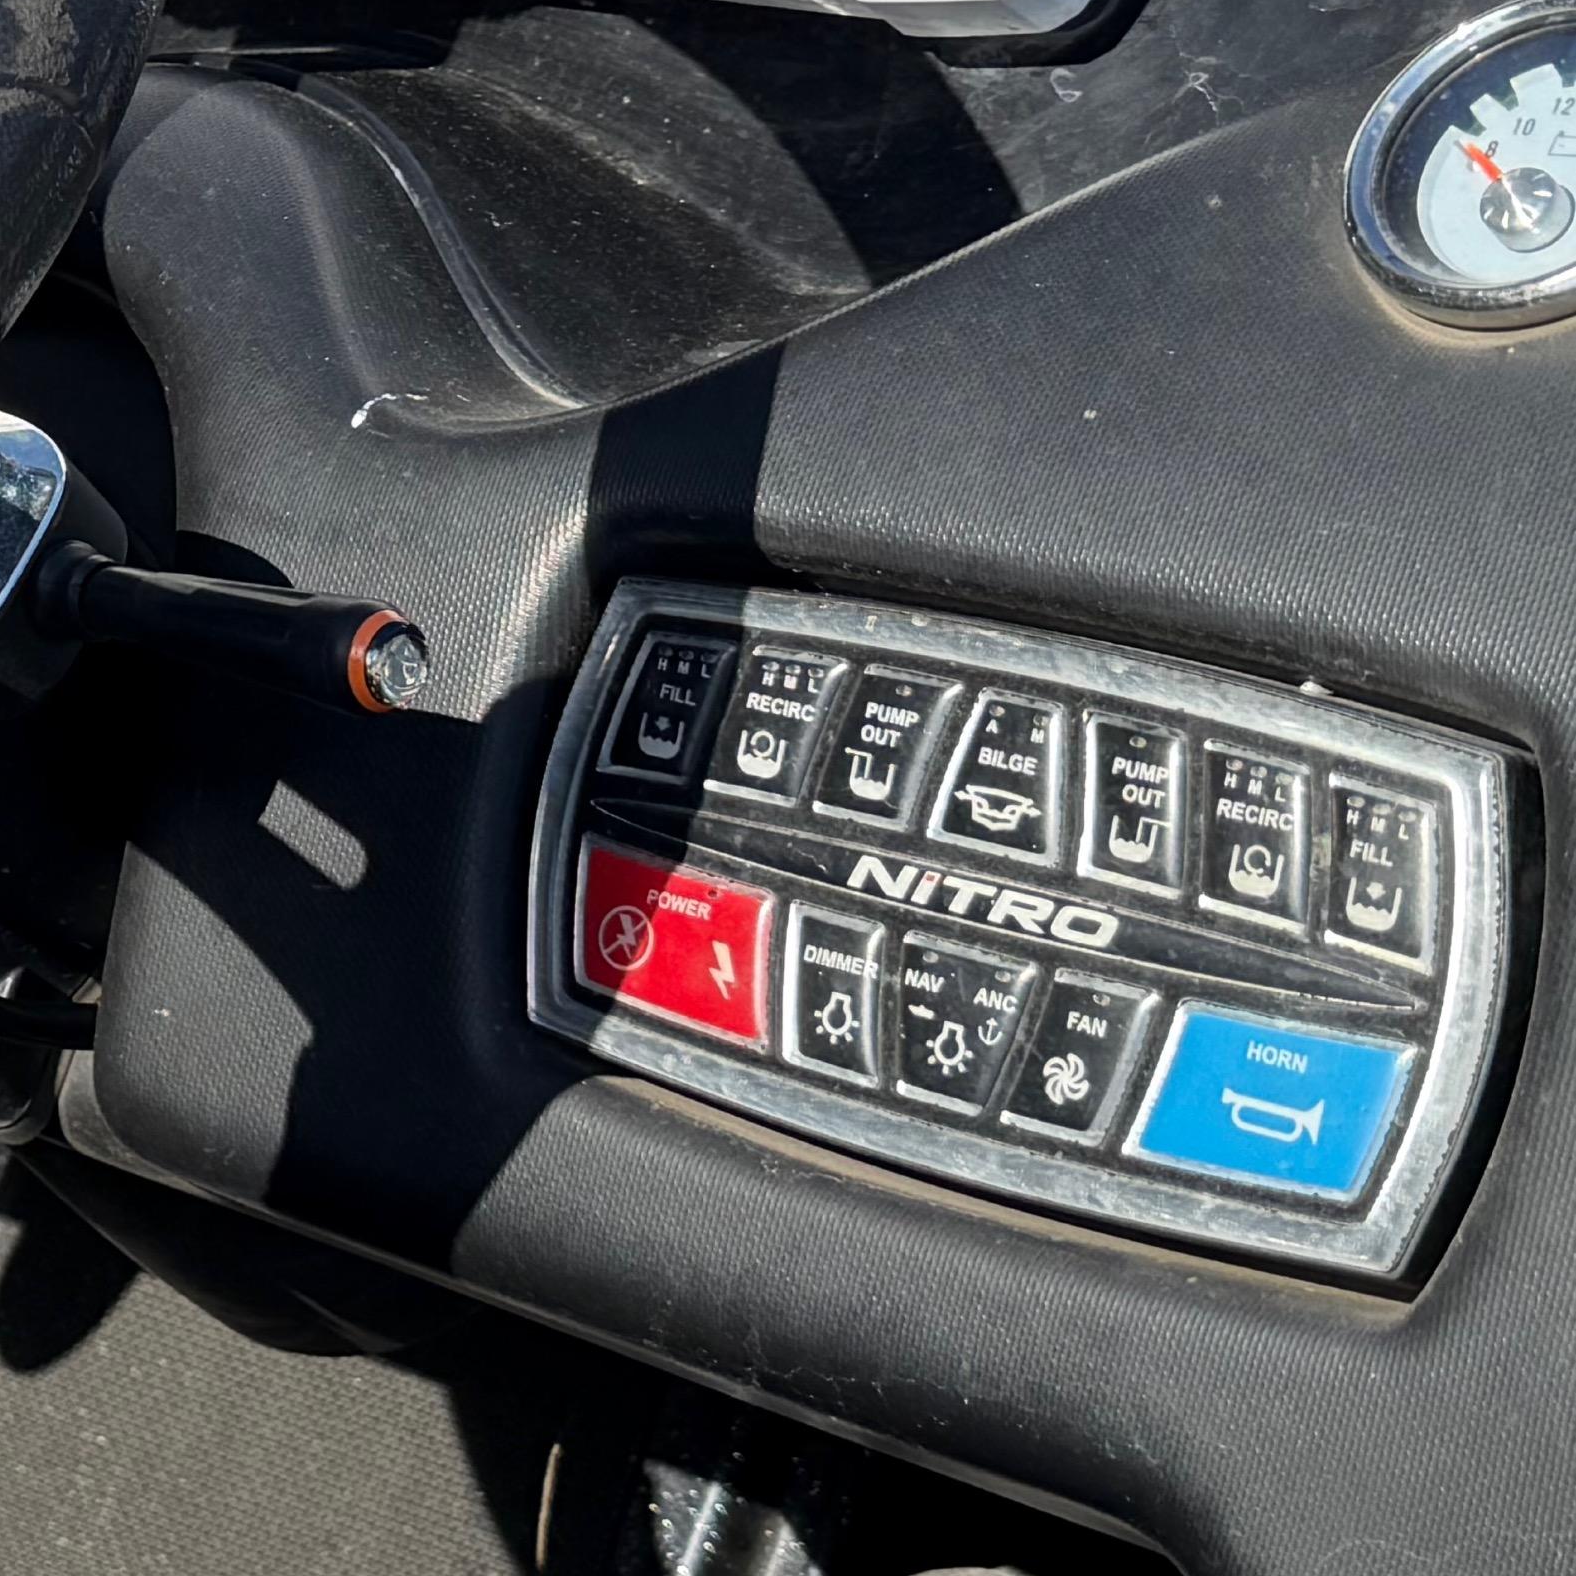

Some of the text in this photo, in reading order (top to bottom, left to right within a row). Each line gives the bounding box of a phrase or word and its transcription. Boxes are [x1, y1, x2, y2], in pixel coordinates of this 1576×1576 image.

[1552, 97, 1575, 116] 12
[1513, 118, 1535, 136] 10
[1485, 140, 1498, 158] 8
[658, 658, 711, 678] H M L
[659, 683, 696, 707] FILL
[762, 672, 820, 693] H M L
[746, 692, 816, 722] RECIRC
[865, 701, 920, 728] PUMP
[861, 724, 901, 748] OUT
[985, 721, 1044, 744] A M
[978, 746, 1039, 776] BILGE
[1111, 756, 1169, 784] PUMP
[1122, 784, 1166, 808] OUT
[1223, 772, 1286, 802] H M L
[1216, 797, 1297, 832] RECIRC
[1347, 808, 1409, 840] H M L
[1349, 840, 1393, 868] FILL
[647, 889, 711, 921] POWER
[846, 854, 1119, 948] NITRO
[803, 944, 879, 979] DIMMER
[904, 968, 1018, 1012] NAV ANC
[1066, 1010, 1108, 1038] FAN
[1247, 1040, 1308, 1074] HORN
